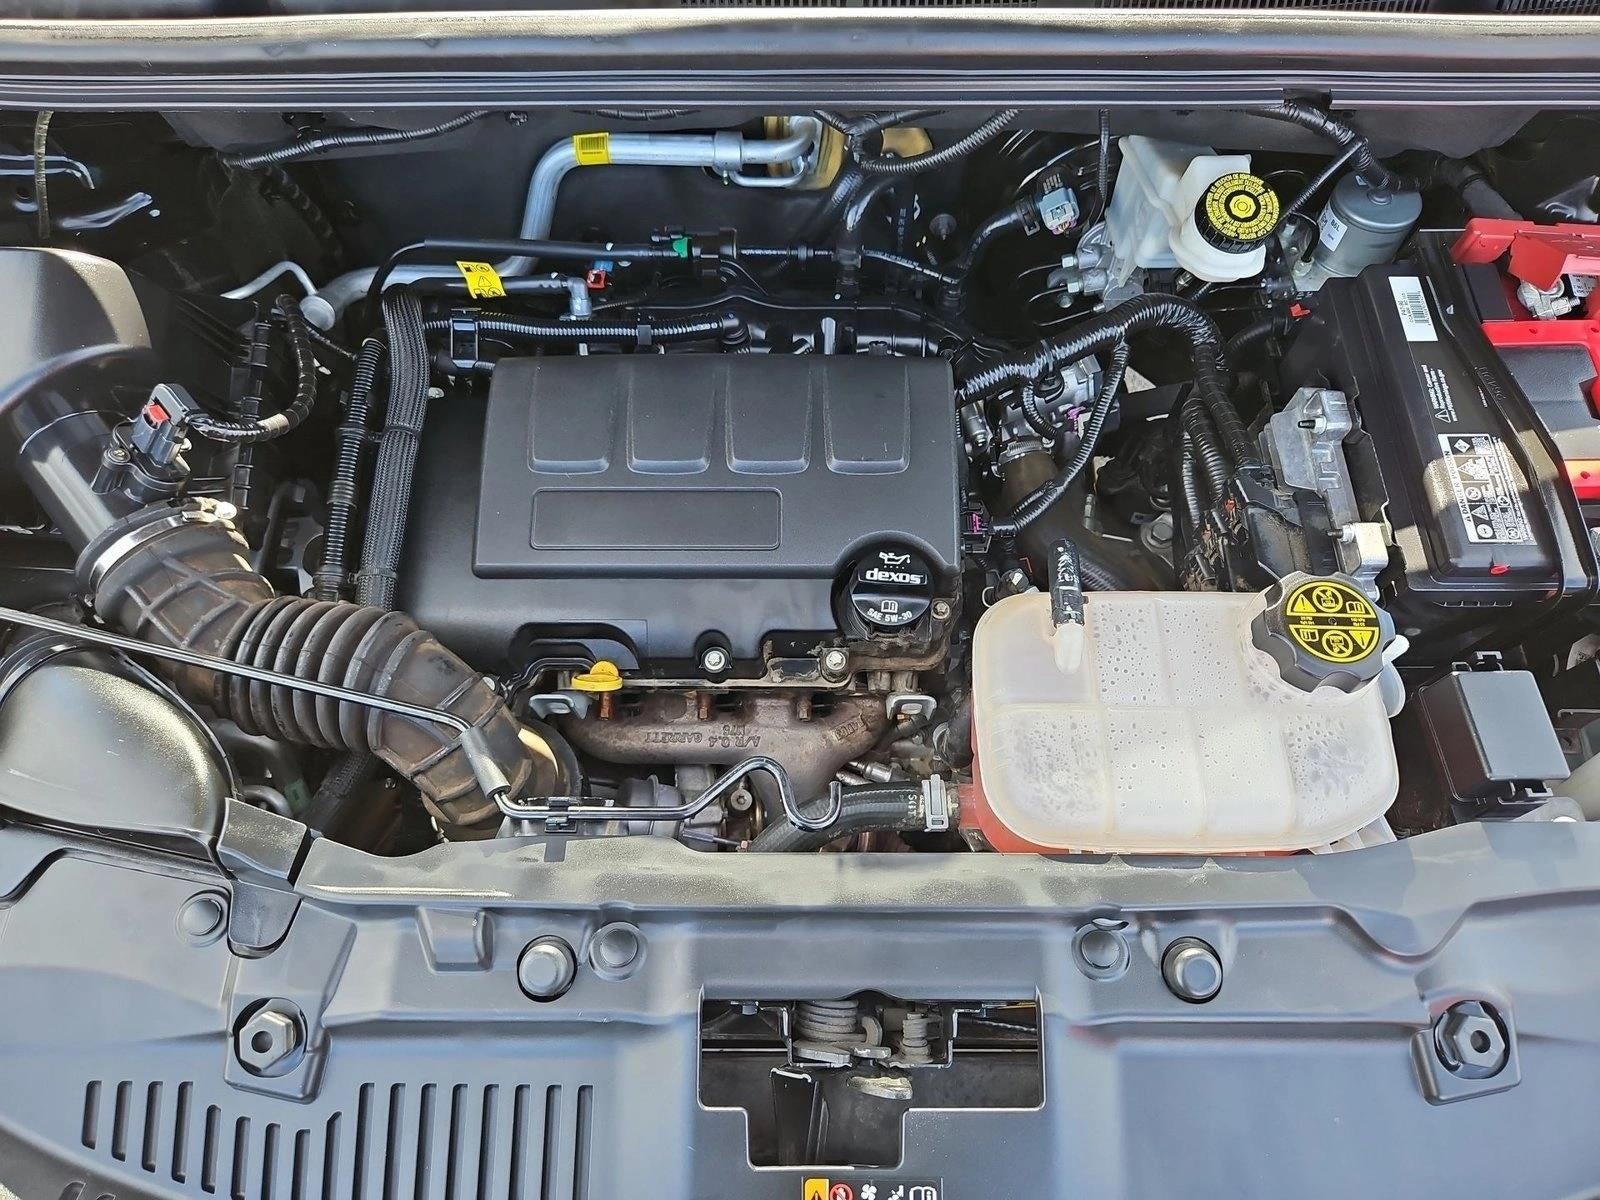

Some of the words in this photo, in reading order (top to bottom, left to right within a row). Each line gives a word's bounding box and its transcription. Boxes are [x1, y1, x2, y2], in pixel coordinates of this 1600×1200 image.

[1443, 450, 1458, 479] POISON
[1453, 481, 1470, 516] DANGER
[865, 567, 924, 585] dexos
[867, 608, 883, 621] SAE
[884, 610, 913, 623] 5W-30
[645, 731, 703, 745] GARRETT
